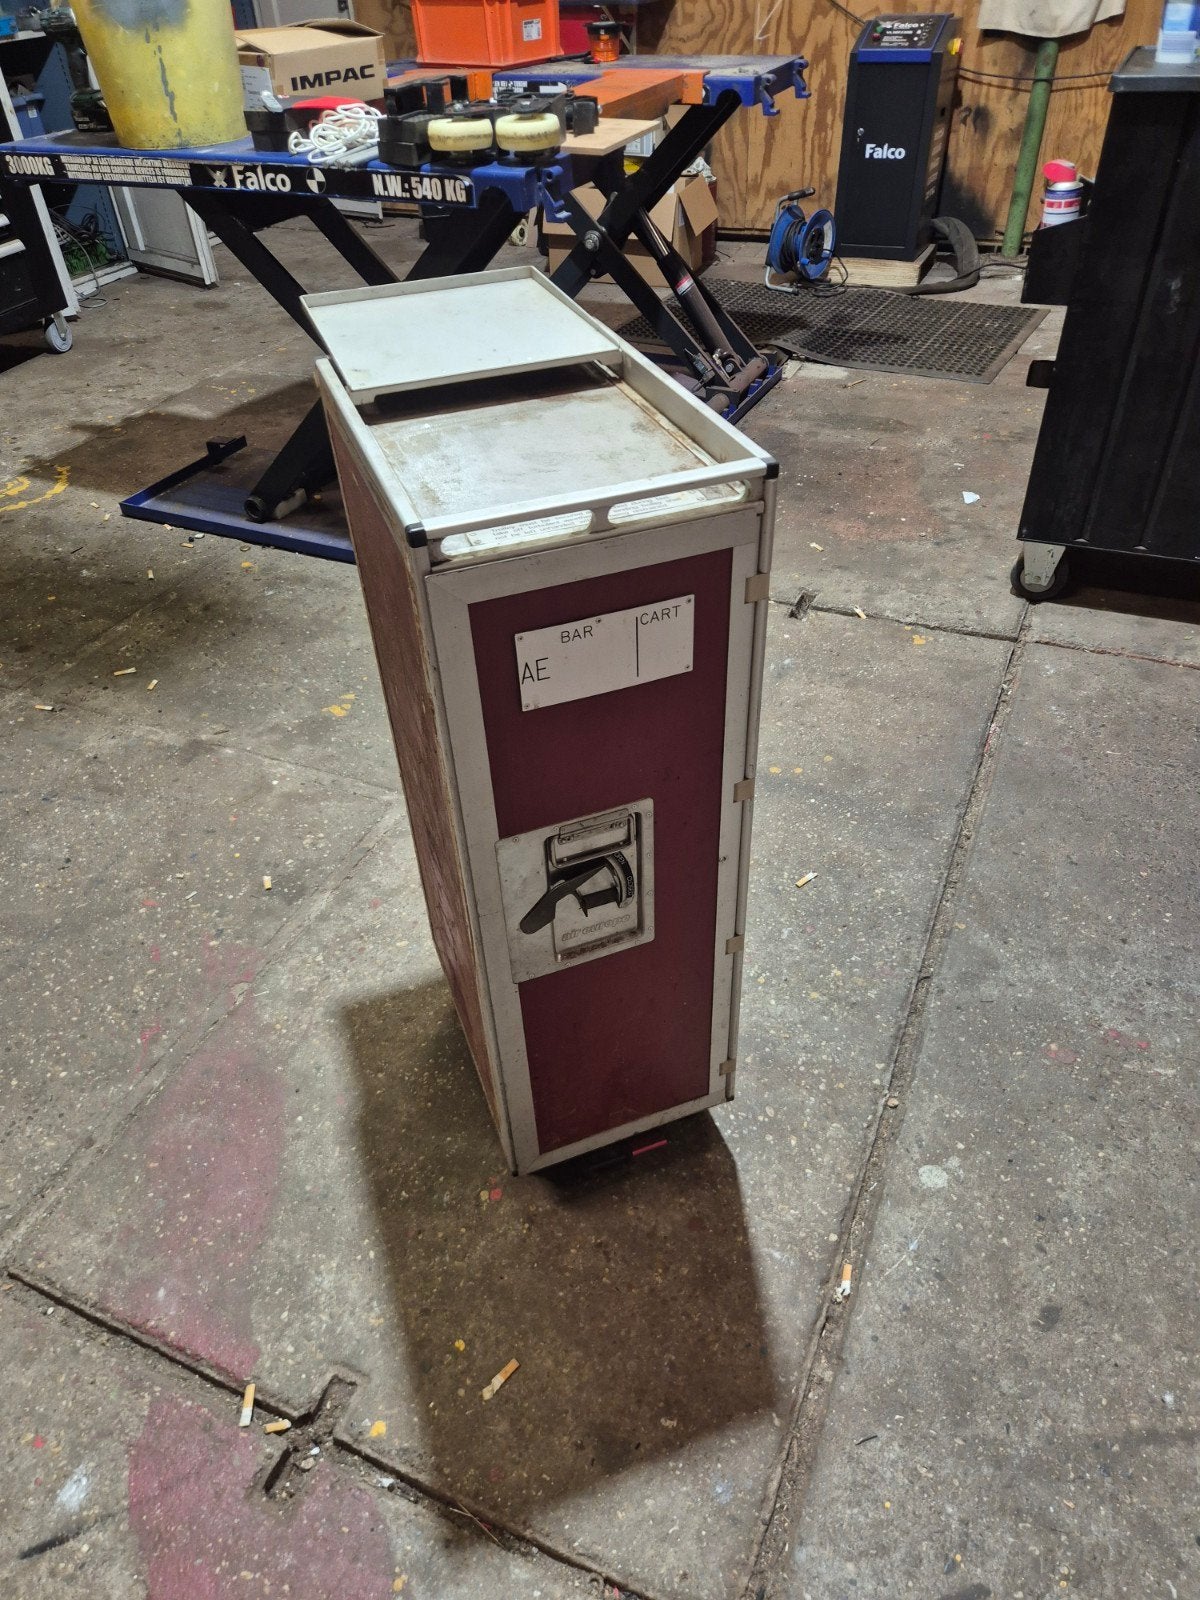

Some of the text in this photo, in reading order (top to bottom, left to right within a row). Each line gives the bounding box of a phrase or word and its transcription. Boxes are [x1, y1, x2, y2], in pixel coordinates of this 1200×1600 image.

[893, 22, 919, 30] Falco
[290, 64, 375, 92] IMPAC
[5, 155, 55, 175] 3000KG
[865, 143, 906, 160] Falco
[231, 165, 292, 193] Falco
[371, 173, 467, 203] N.W.: 540 KG
[560, 604, 682, 644] BAR CART
[521, 657, 551, 685] AE
